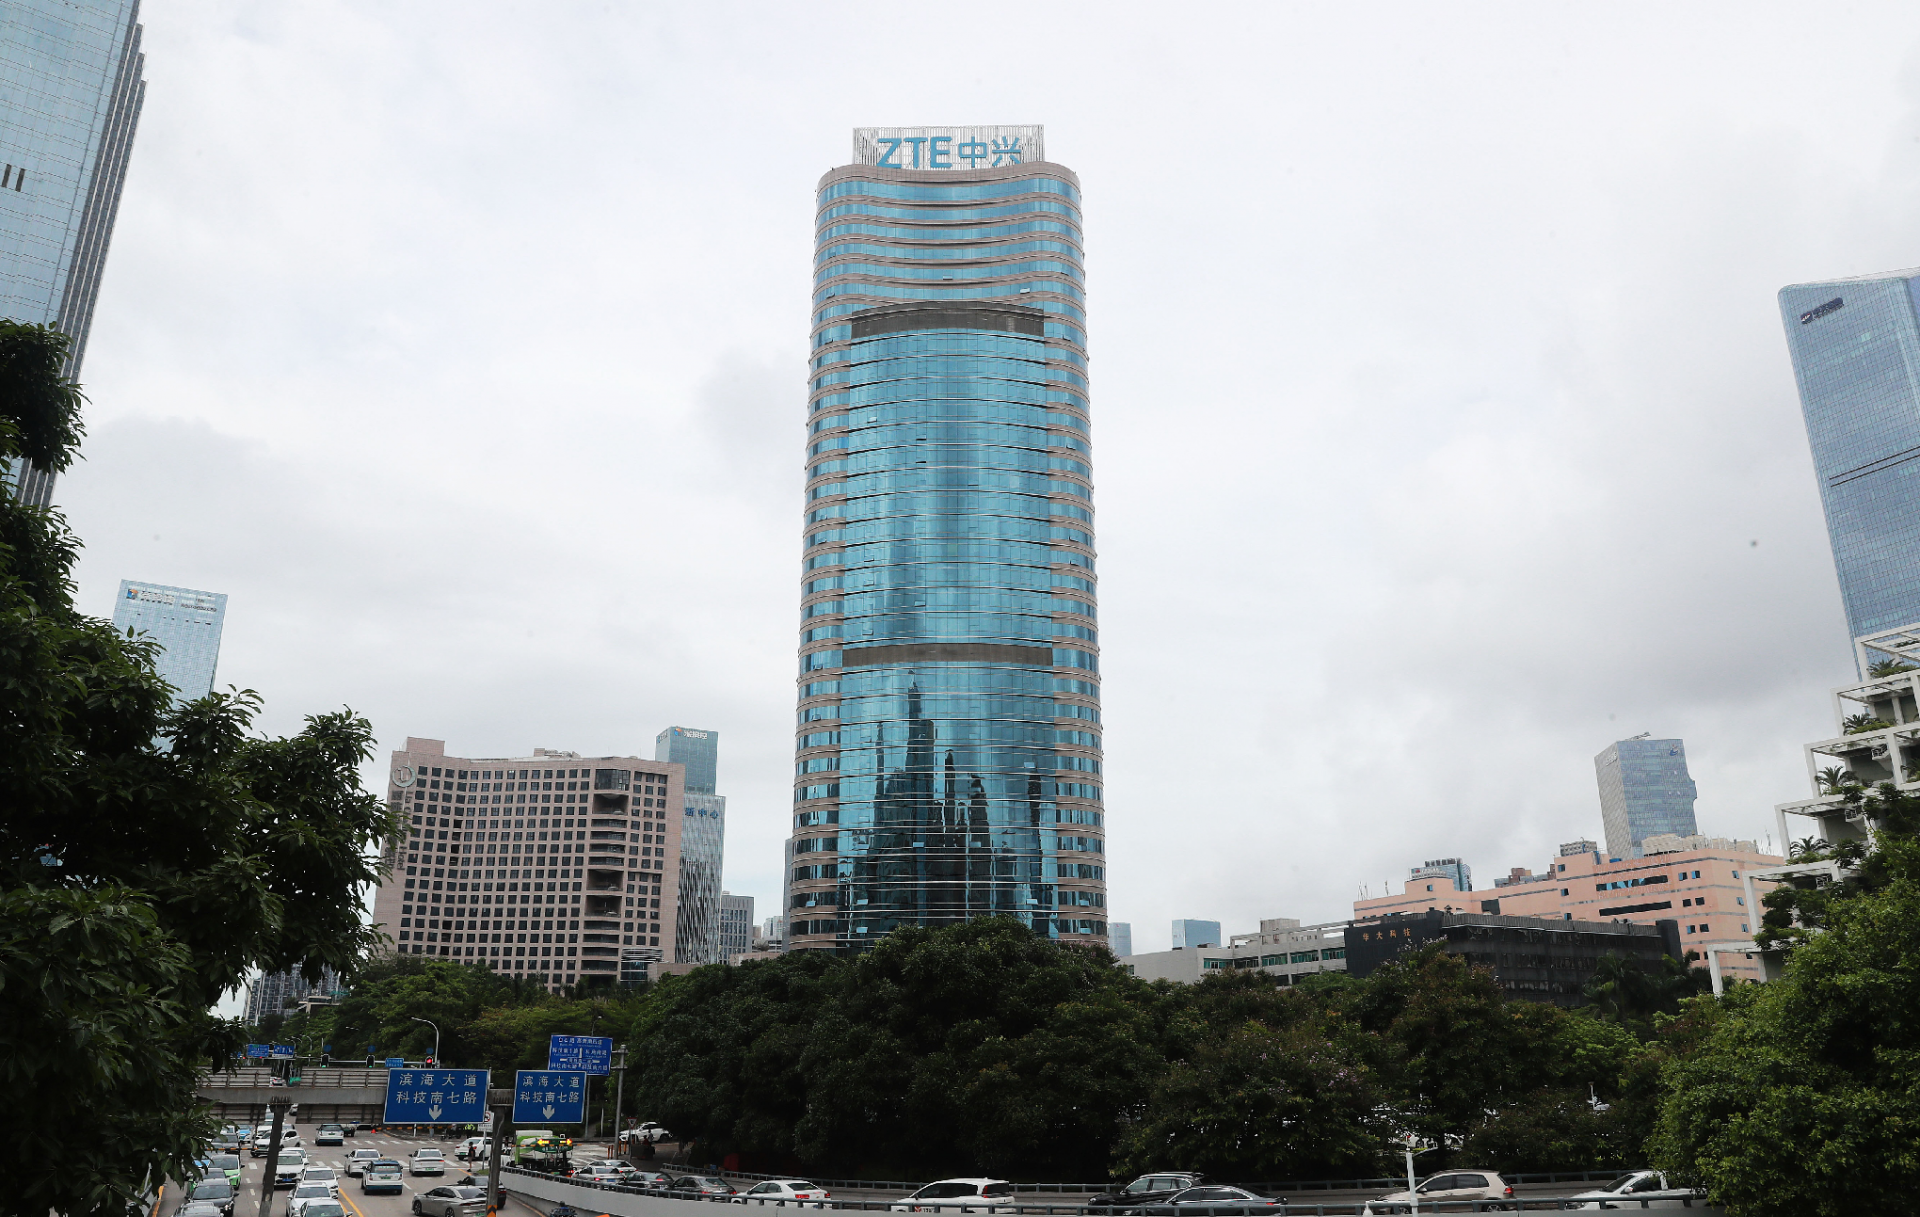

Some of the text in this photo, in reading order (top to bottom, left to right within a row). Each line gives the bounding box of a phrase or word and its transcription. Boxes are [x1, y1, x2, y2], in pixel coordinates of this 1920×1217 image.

[876, 136, 1022, 169] ZTE 中兴
[399, 1073, 477, 1086] 滨海大道
[522, 1075, 580, 1088] 滨海大道
[396, 1091, 477, 1104] 科技南七路
[519, 1091, 579, 1103] 科技南七路
